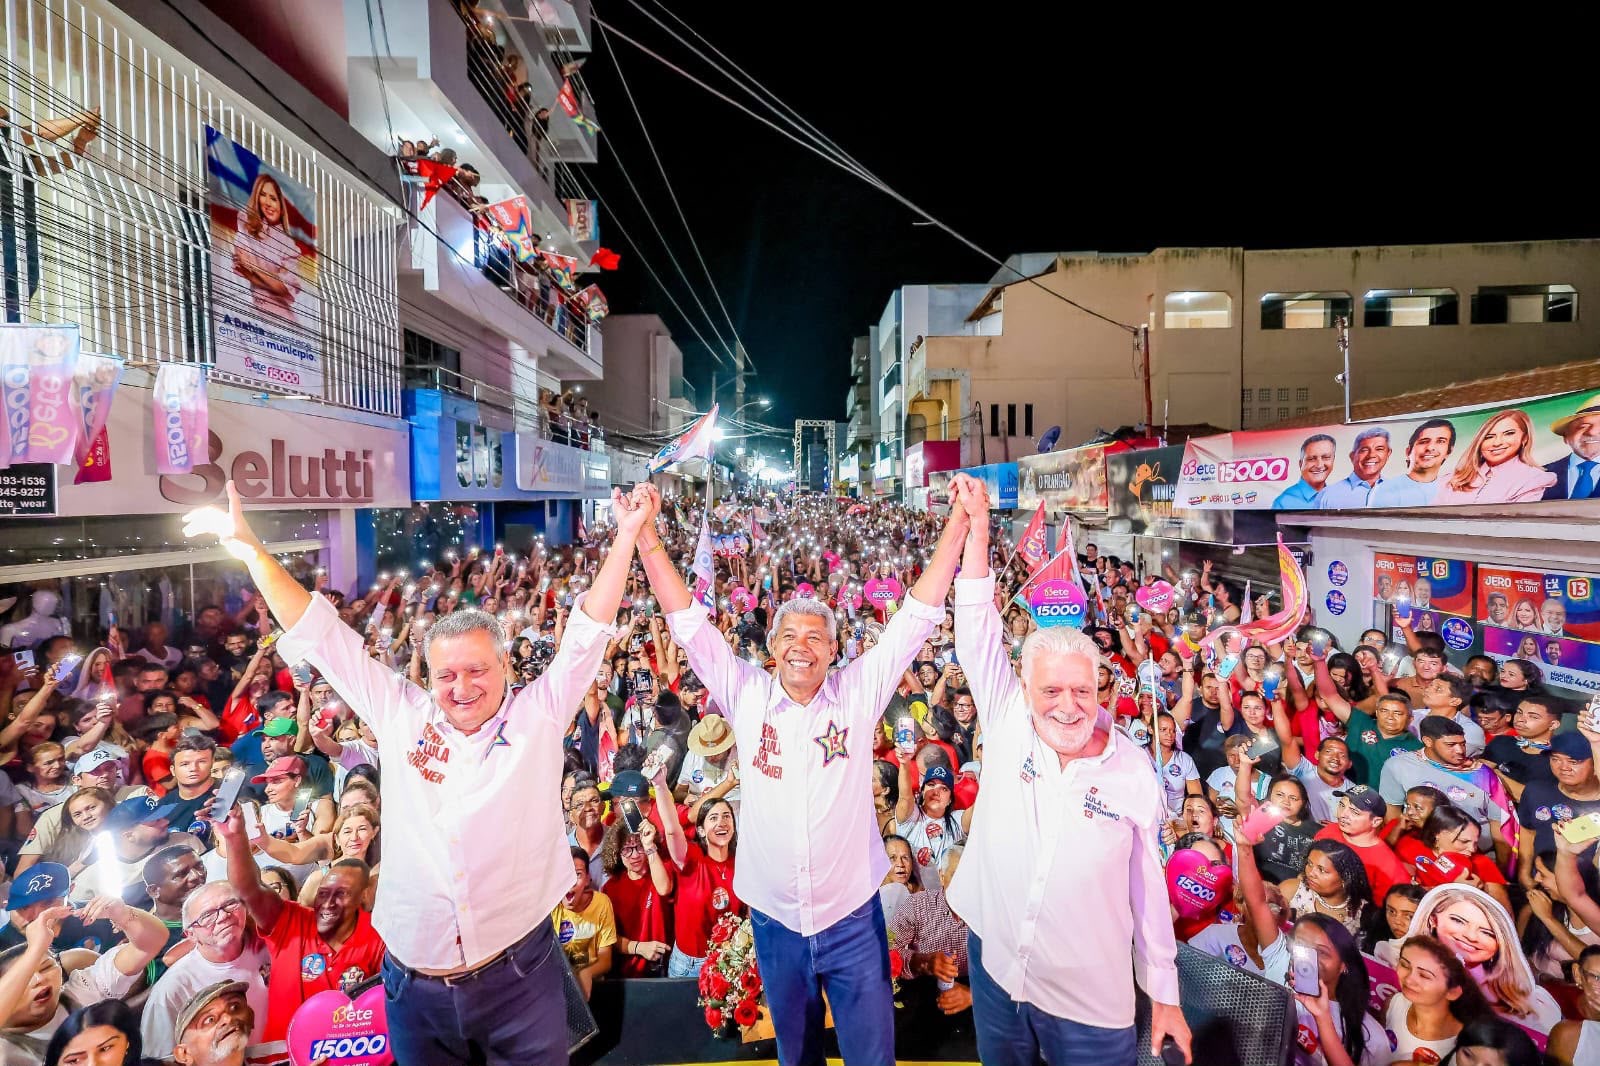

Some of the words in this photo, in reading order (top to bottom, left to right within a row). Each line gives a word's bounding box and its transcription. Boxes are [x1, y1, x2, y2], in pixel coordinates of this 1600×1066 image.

[268, 367, 299, 384] 15000
[1182, 459, 1216, 476] Bete
[1219, 459, 1287, 481] 15000
[1152, 484, 1175, 500] VINIC
[1376, 560, 1395, 570] JERO
[1434, 562, 1446, 577] 13
[1485, 575, 1512, 588] JERO
[1517, 585, 1538, 593] 15.000
[1571, 581, 1588, 596] 13
[1037, 604, 1081, 616] 15000
[423, 741, 450, 764] LULA
[1085, 793, 1102, 807] LULA
[1084, 809, 1094, 819] 13
[1177, 876, 1216, 901] 15000
[333, 1005, 373, 1023] Bete
[312, 1034, 386, 1060] 15000
